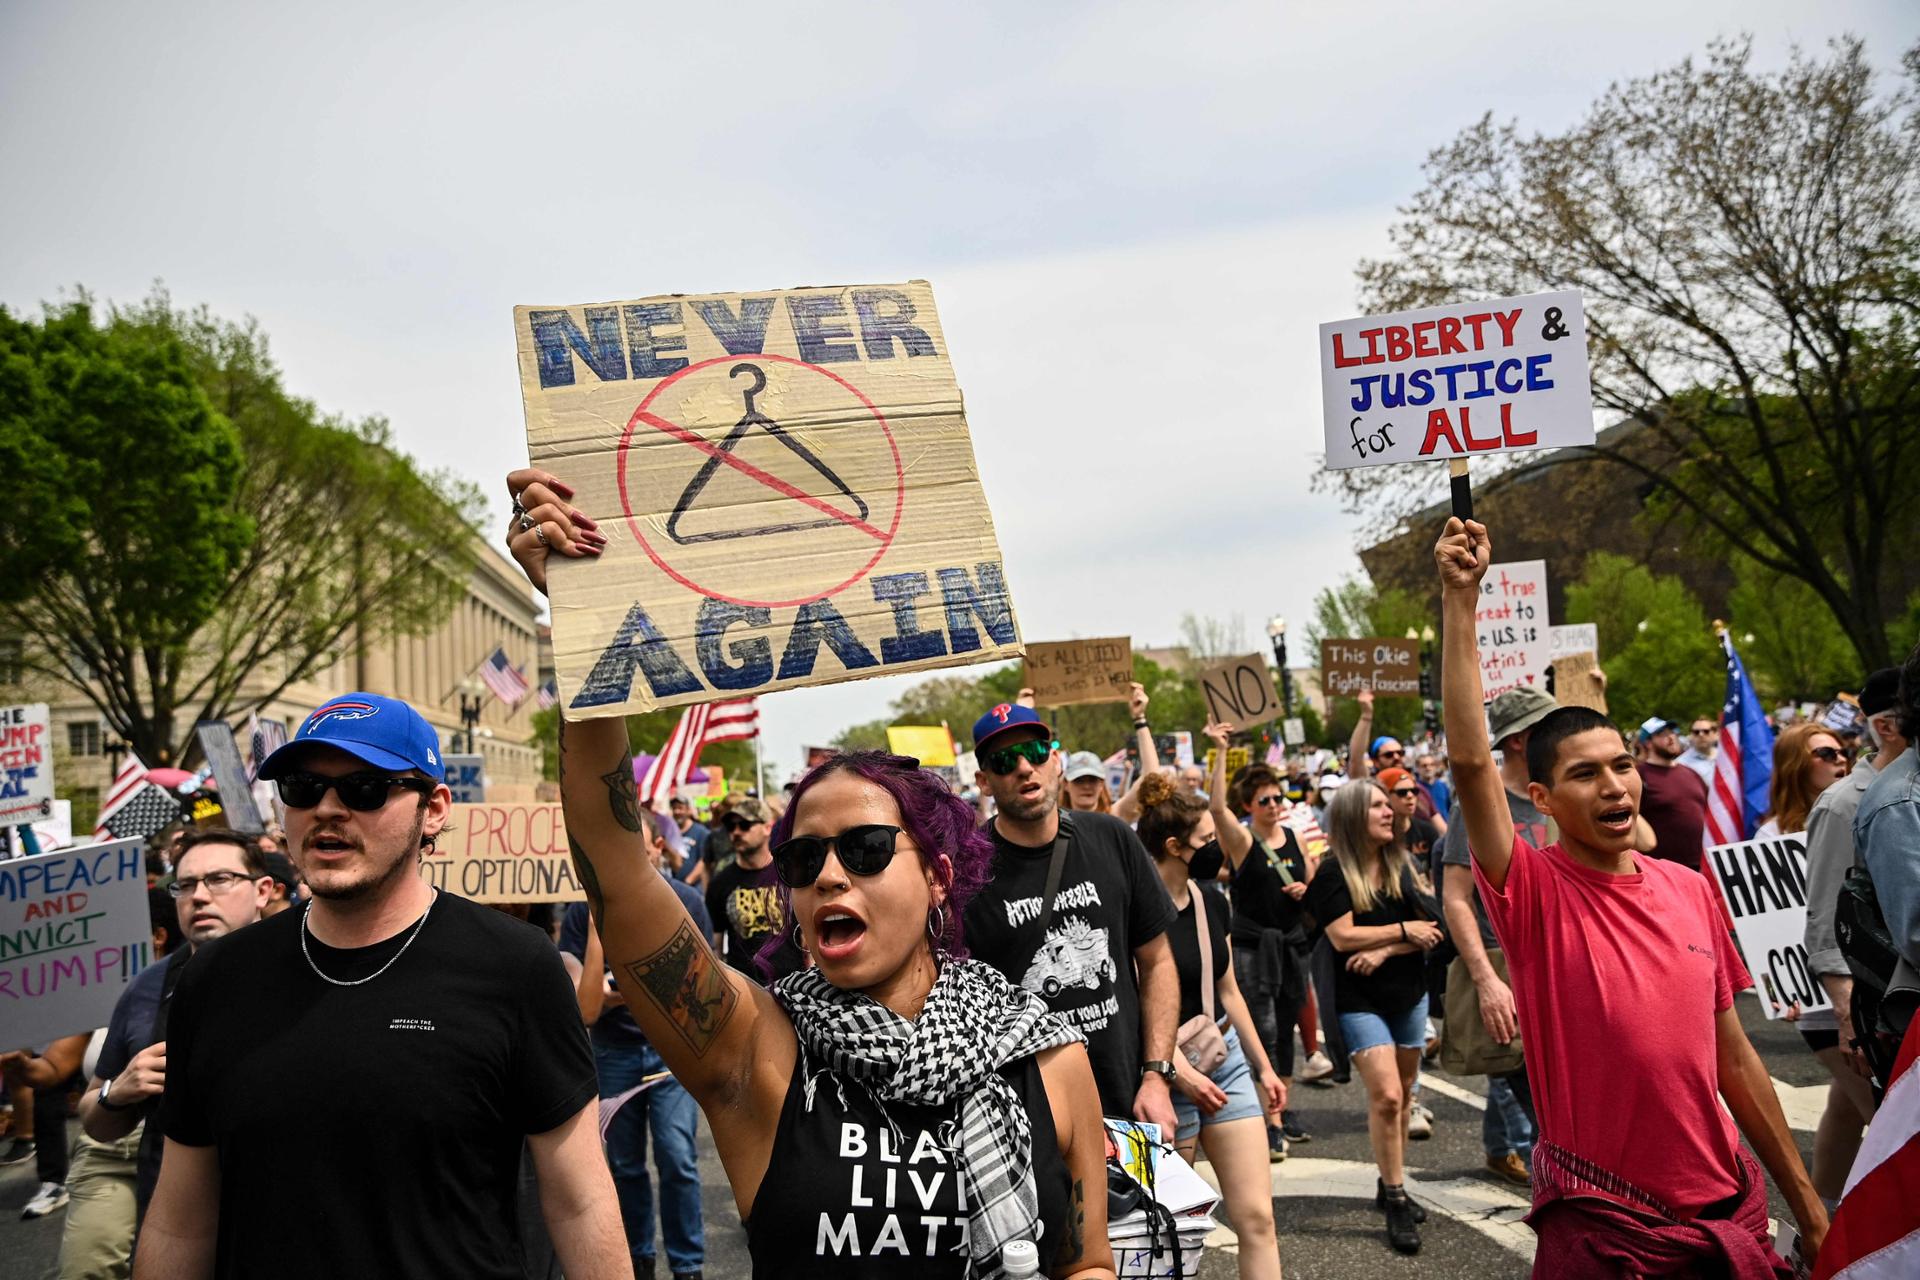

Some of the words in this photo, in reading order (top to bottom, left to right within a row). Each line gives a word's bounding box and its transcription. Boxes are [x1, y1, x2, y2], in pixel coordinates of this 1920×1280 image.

[529, 289, 938, 390] NEVER
[1332, 308, 1523, 369] LIBERTY
[1541, 306, 1570, 341] &
[1351, 354, 1554, 412] JUSTICE
[1350, 416, 1396, 459] for
[1419, 403, 1538, 455] ALL
[1500, 571, 1536, 596] true
[1475, 602, 1511, 620] reat
[1516, 600, 1535, 619] to
[569, 561, 1018, 709] AGAIN
[1055, 648, 1083, 665] ALL
[1328, 645, 1367, 664] This
[1373, 645, 1410, 665] Okie
[1523, 627, 1537, 642] is
[0, 724, 44, 748] UMP
[444, 765, 481, 787] CK
[466, 806, 568, 856] PROCE
[0, 847, 140, 902] MPEACH
[420, 859, 454, 891] OT
[462, 858, 584, 896] OPTIONA
[24, 892, 88, 922] AND
[0, 912, 106, 957] NVICT
[0, 942, 147, 999] RUMP!!!
[840, 1122, 963, 1164] BLA
[851, 1165, 968, 1211] LIV
[816, 1212, 971, 1256] MATT
